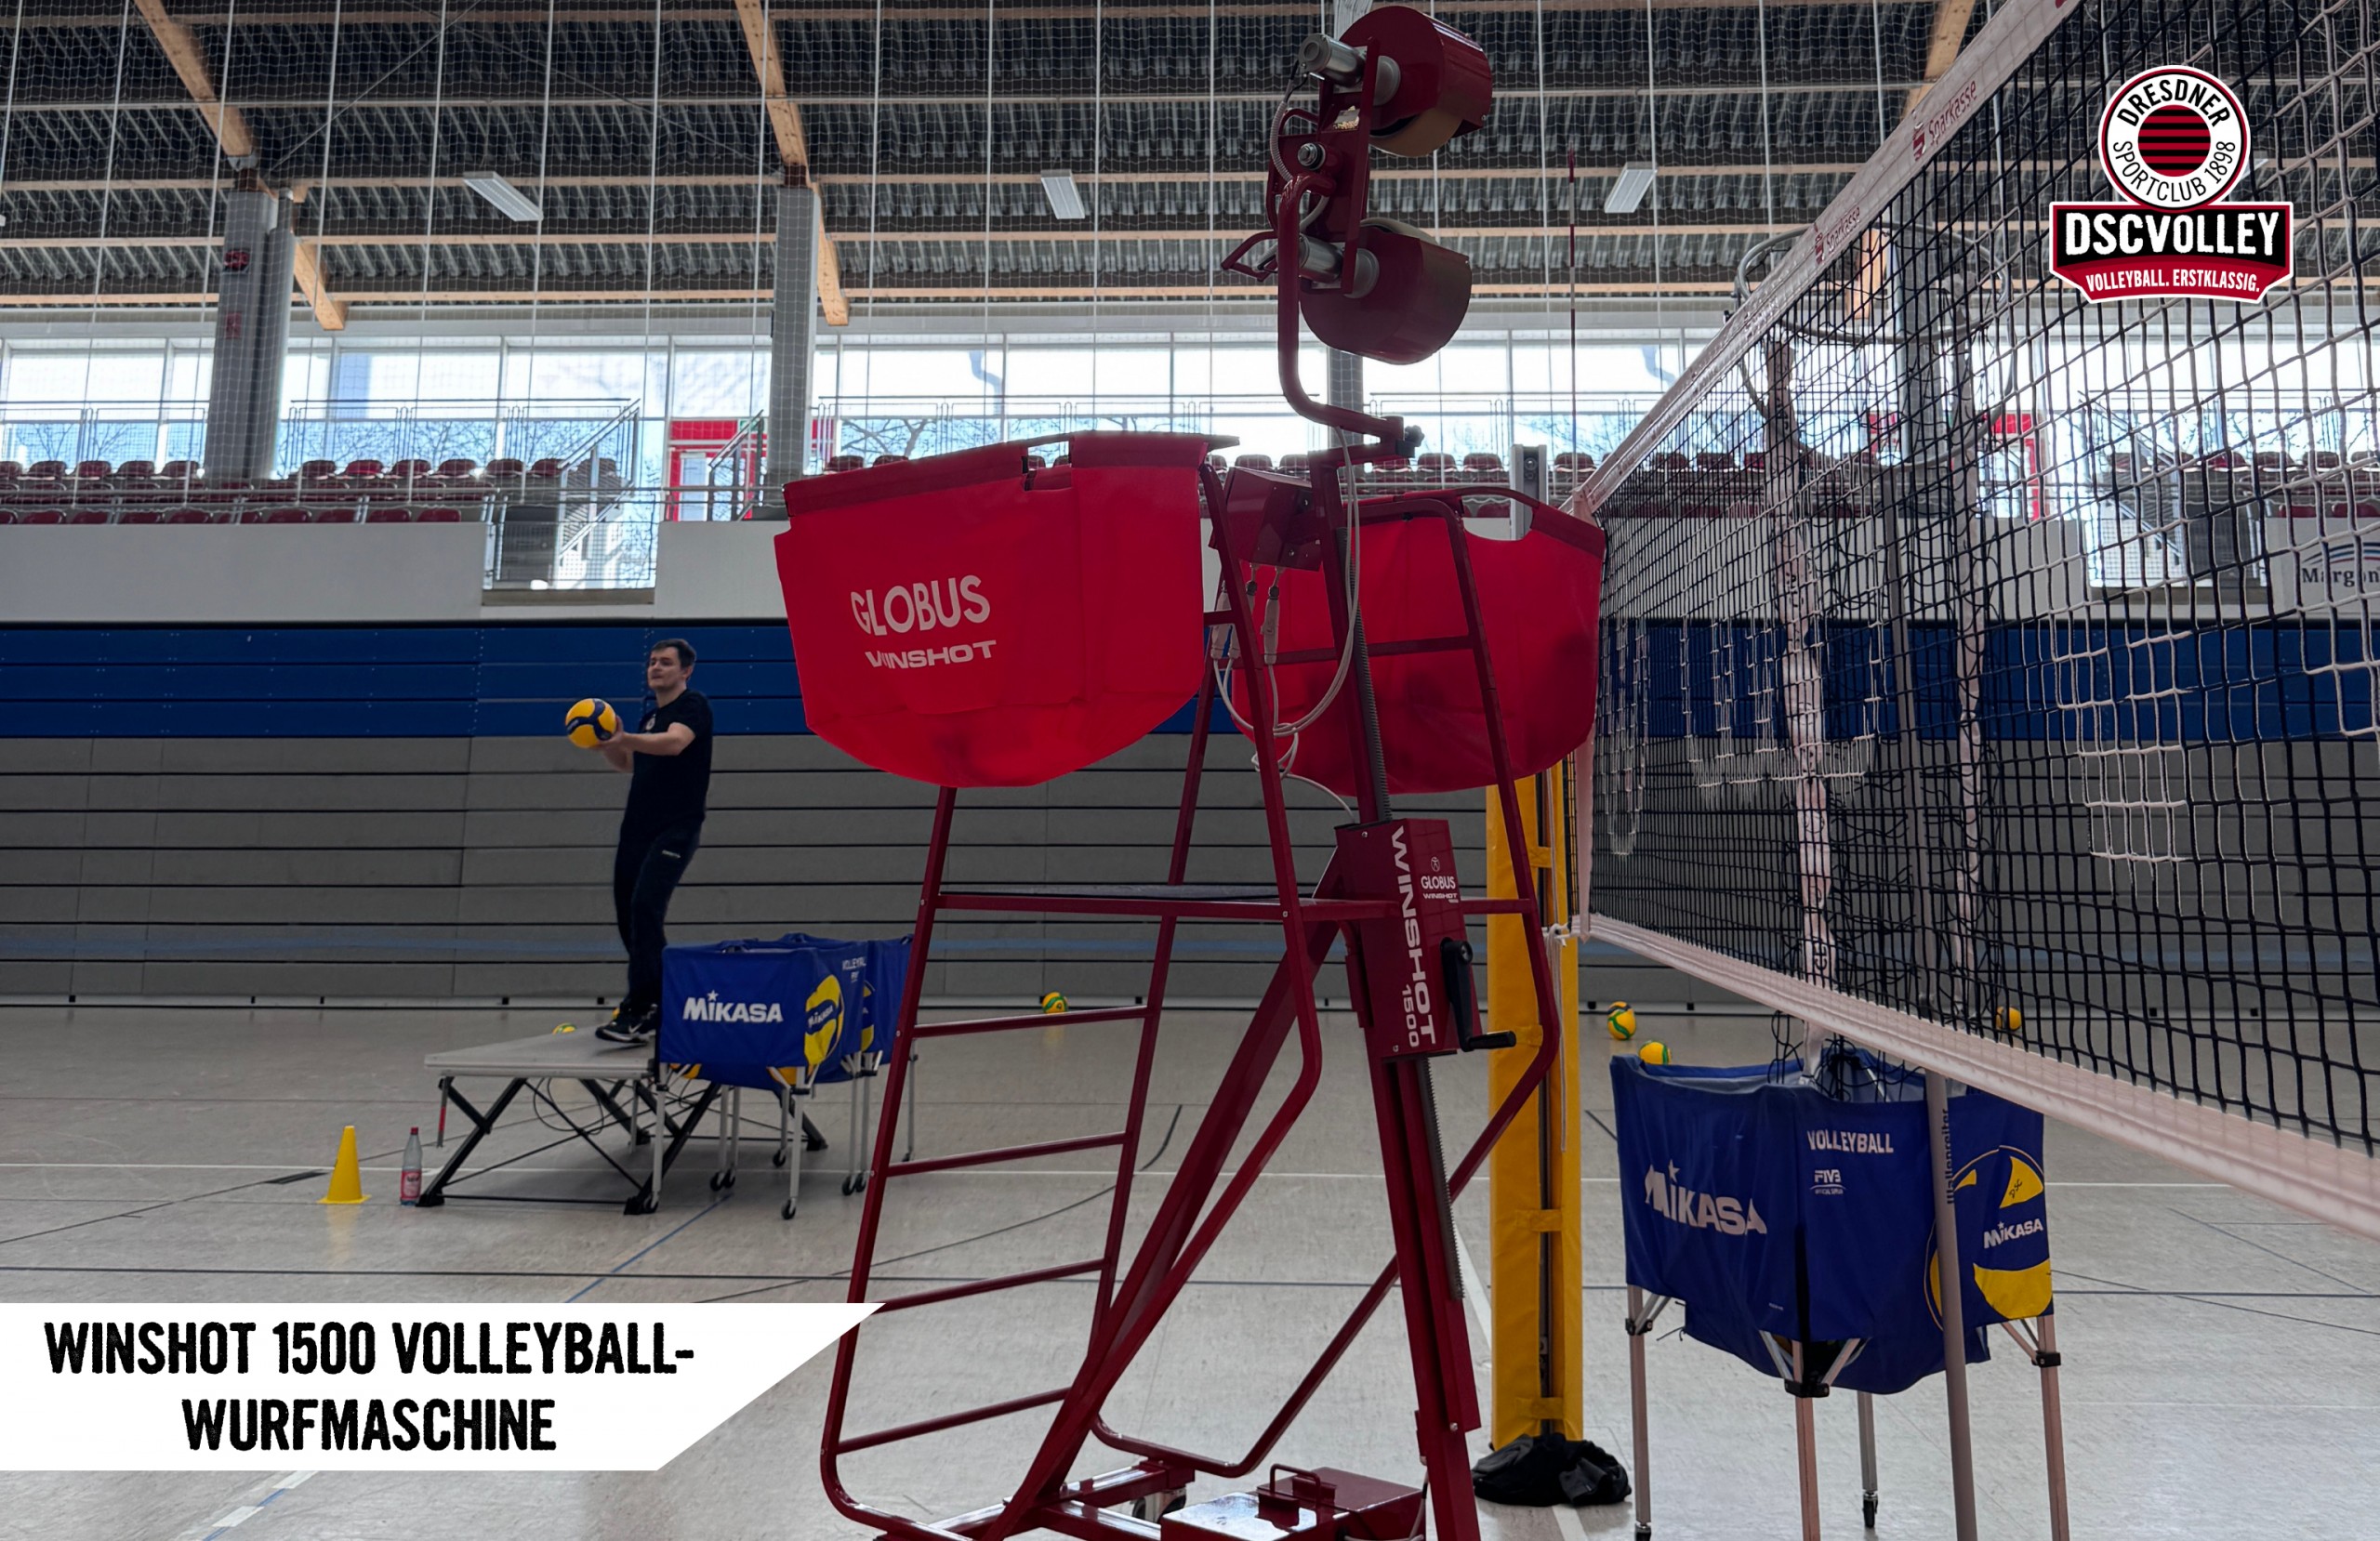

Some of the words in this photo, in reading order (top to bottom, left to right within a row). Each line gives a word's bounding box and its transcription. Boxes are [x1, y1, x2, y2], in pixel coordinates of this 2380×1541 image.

[1928, 80, 1977, 147] Sparkasse
[850, 574, 991, 636] GLOBUS
[865, 639, 997, 669] WINSHOT
[1421, 876, 1456, 889] GLOBUS
[1391, 825, 1436, 1045] WINSHOT
[1401, 983, 1420, 1047] 1500
[1807, 1128, 1894, 1154] VOLLEYBALL
[1814, 1168, 1842, 1183] FIVB
